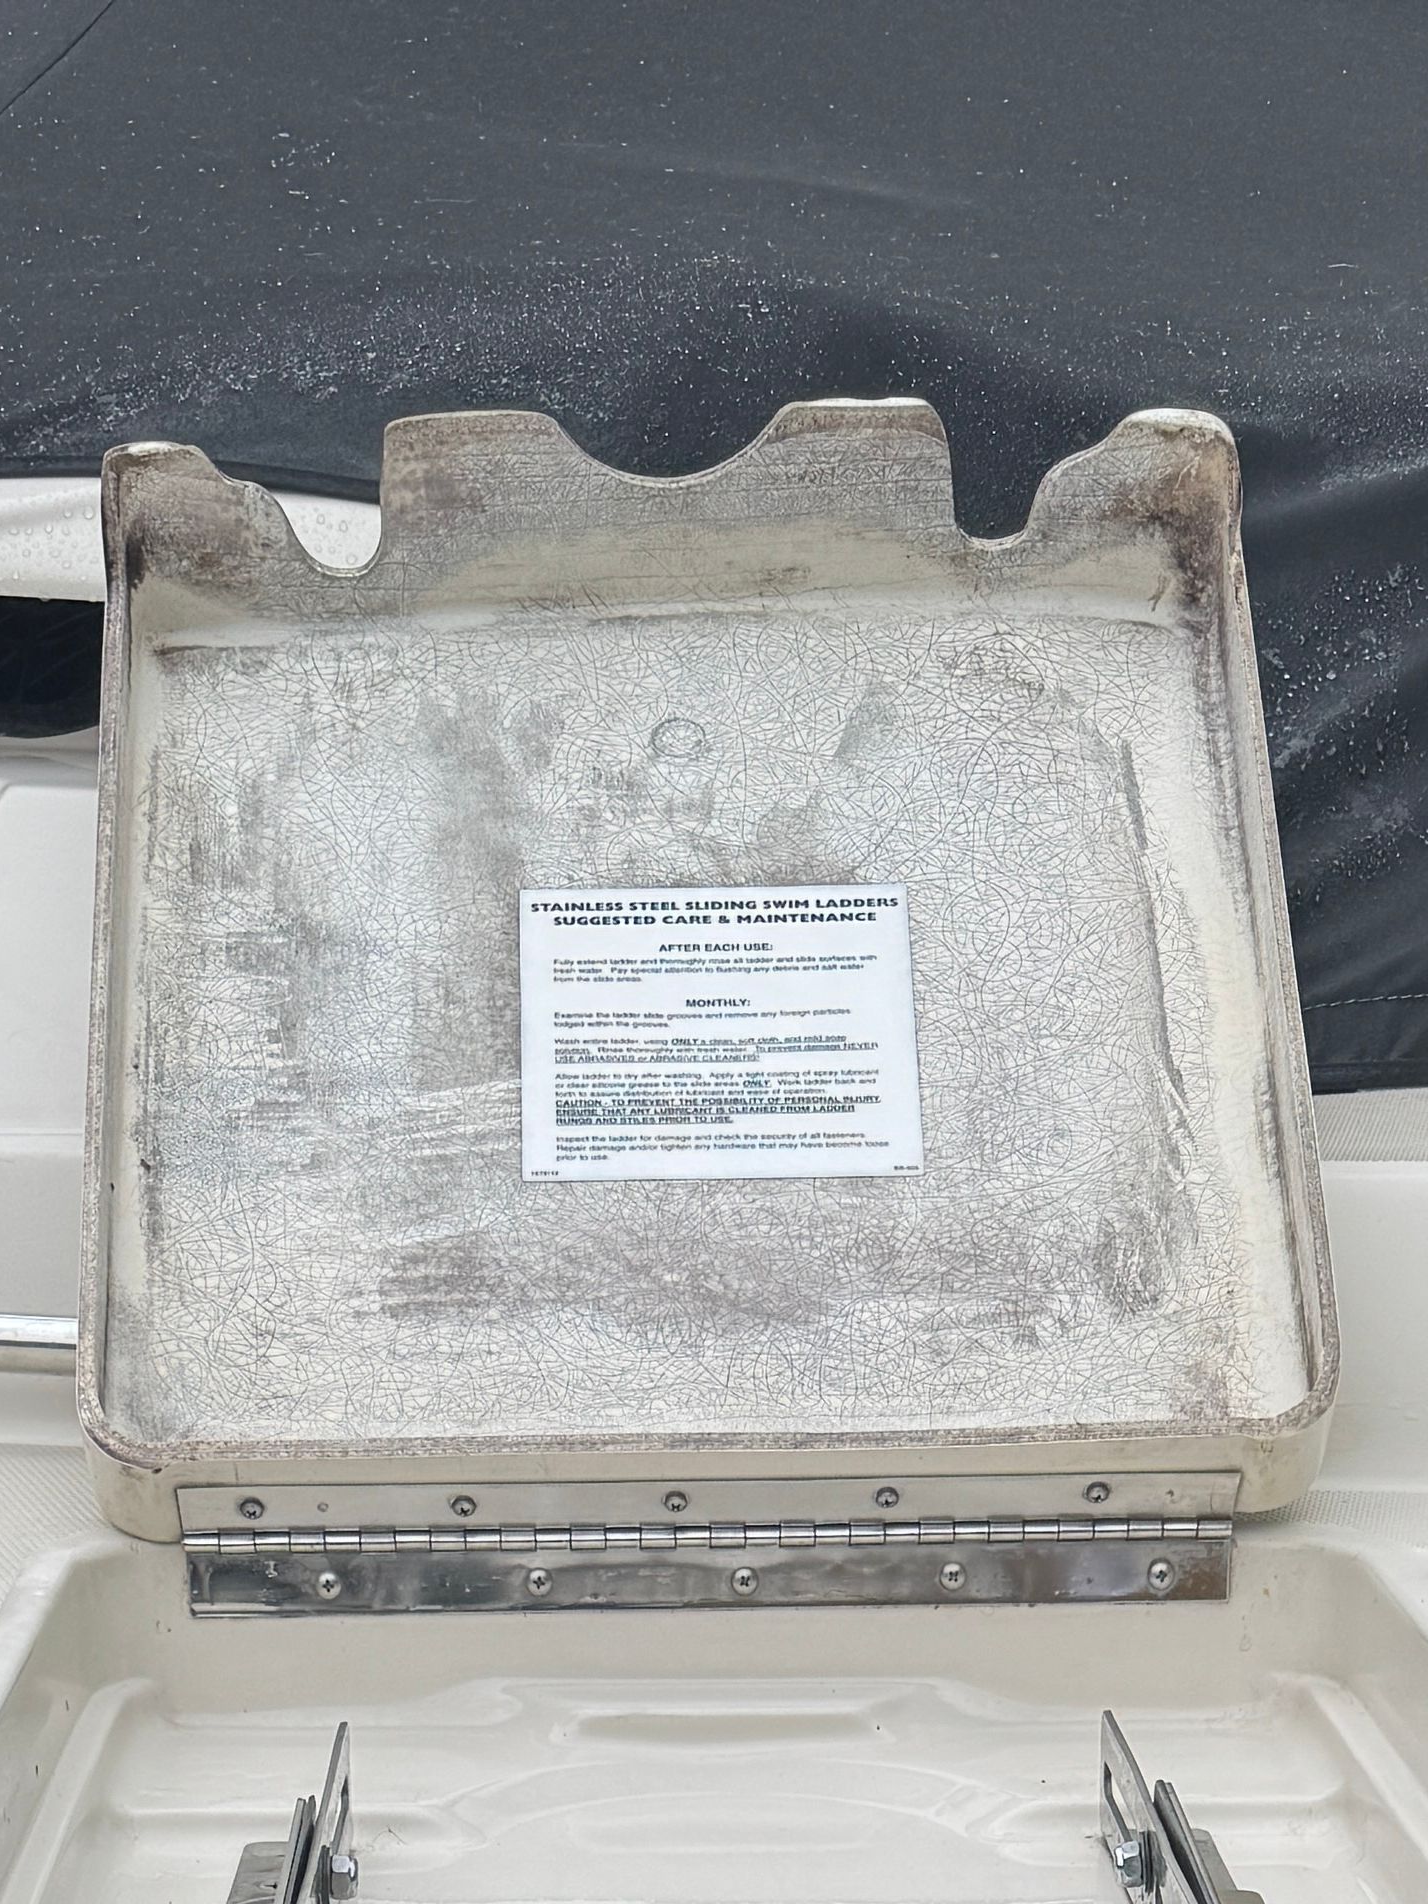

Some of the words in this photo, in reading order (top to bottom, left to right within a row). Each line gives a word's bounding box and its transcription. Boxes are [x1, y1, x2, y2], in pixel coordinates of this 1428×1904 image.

[531, 902, 624, 912] STAINLESS
[629, 902, 680, 911] STEEL
[685, 901, 757, 910] SLIDING
[763, 900, 809, 909] SWIM
[816, 898, 898, 908] LADDERS
[553, 916, 656, 926] SUGGESTED
[662, 915, 712, 924] CARE
[718, 915, 730, 923] &
[737, 913, 877, 923] MAINTENANCE
[659, 944, 701, 952] AFTER
[744, 943, 773, 951] USE:
[660, 958, 706, 966] thoroughly
[716, 965, 751, 973] flushing
[753, 965, 770, 973] any
[686, 999, 750, 1007] MONTHLY:
[813, 1008, 851, 1016] particles
[767, 1070, 799, 1078] coating
[556, 1100, 602, 1108] CAUTION
[611, 1099, 625, 1107] TO
[627, 1099, 674, 1107] PREVENT
[679, 1098, 699, 1106] THE
[701, 1097, 764, 1106] POSSIBILITY
[767, 1097, 781, 1105] OF
[784, 1096, 840, 1104] PERSONAL
[556, 1108, 598, 1117] ENSURE
[602, 1108, 627, 1116] THAT
[630, 1108, 650, 1116] ANY
[654, 1107, 712, 1116] LUBRICANT
[716, 1107, 725, 1115] IS
[728, 1106, 777, 1114] CLEANED
[780, 1105, 810, 1113] FROM
[813, 1104, 855, 1113] LADDER
[556, 1118, 592, 1126] RUNGS
[595, 1117, 617, 1125] AND
[621, 1117, 655, 1125] STILES
[658, 1116, 692, 1124] PRIOR
[694, 1116, 707, 1124] TO
